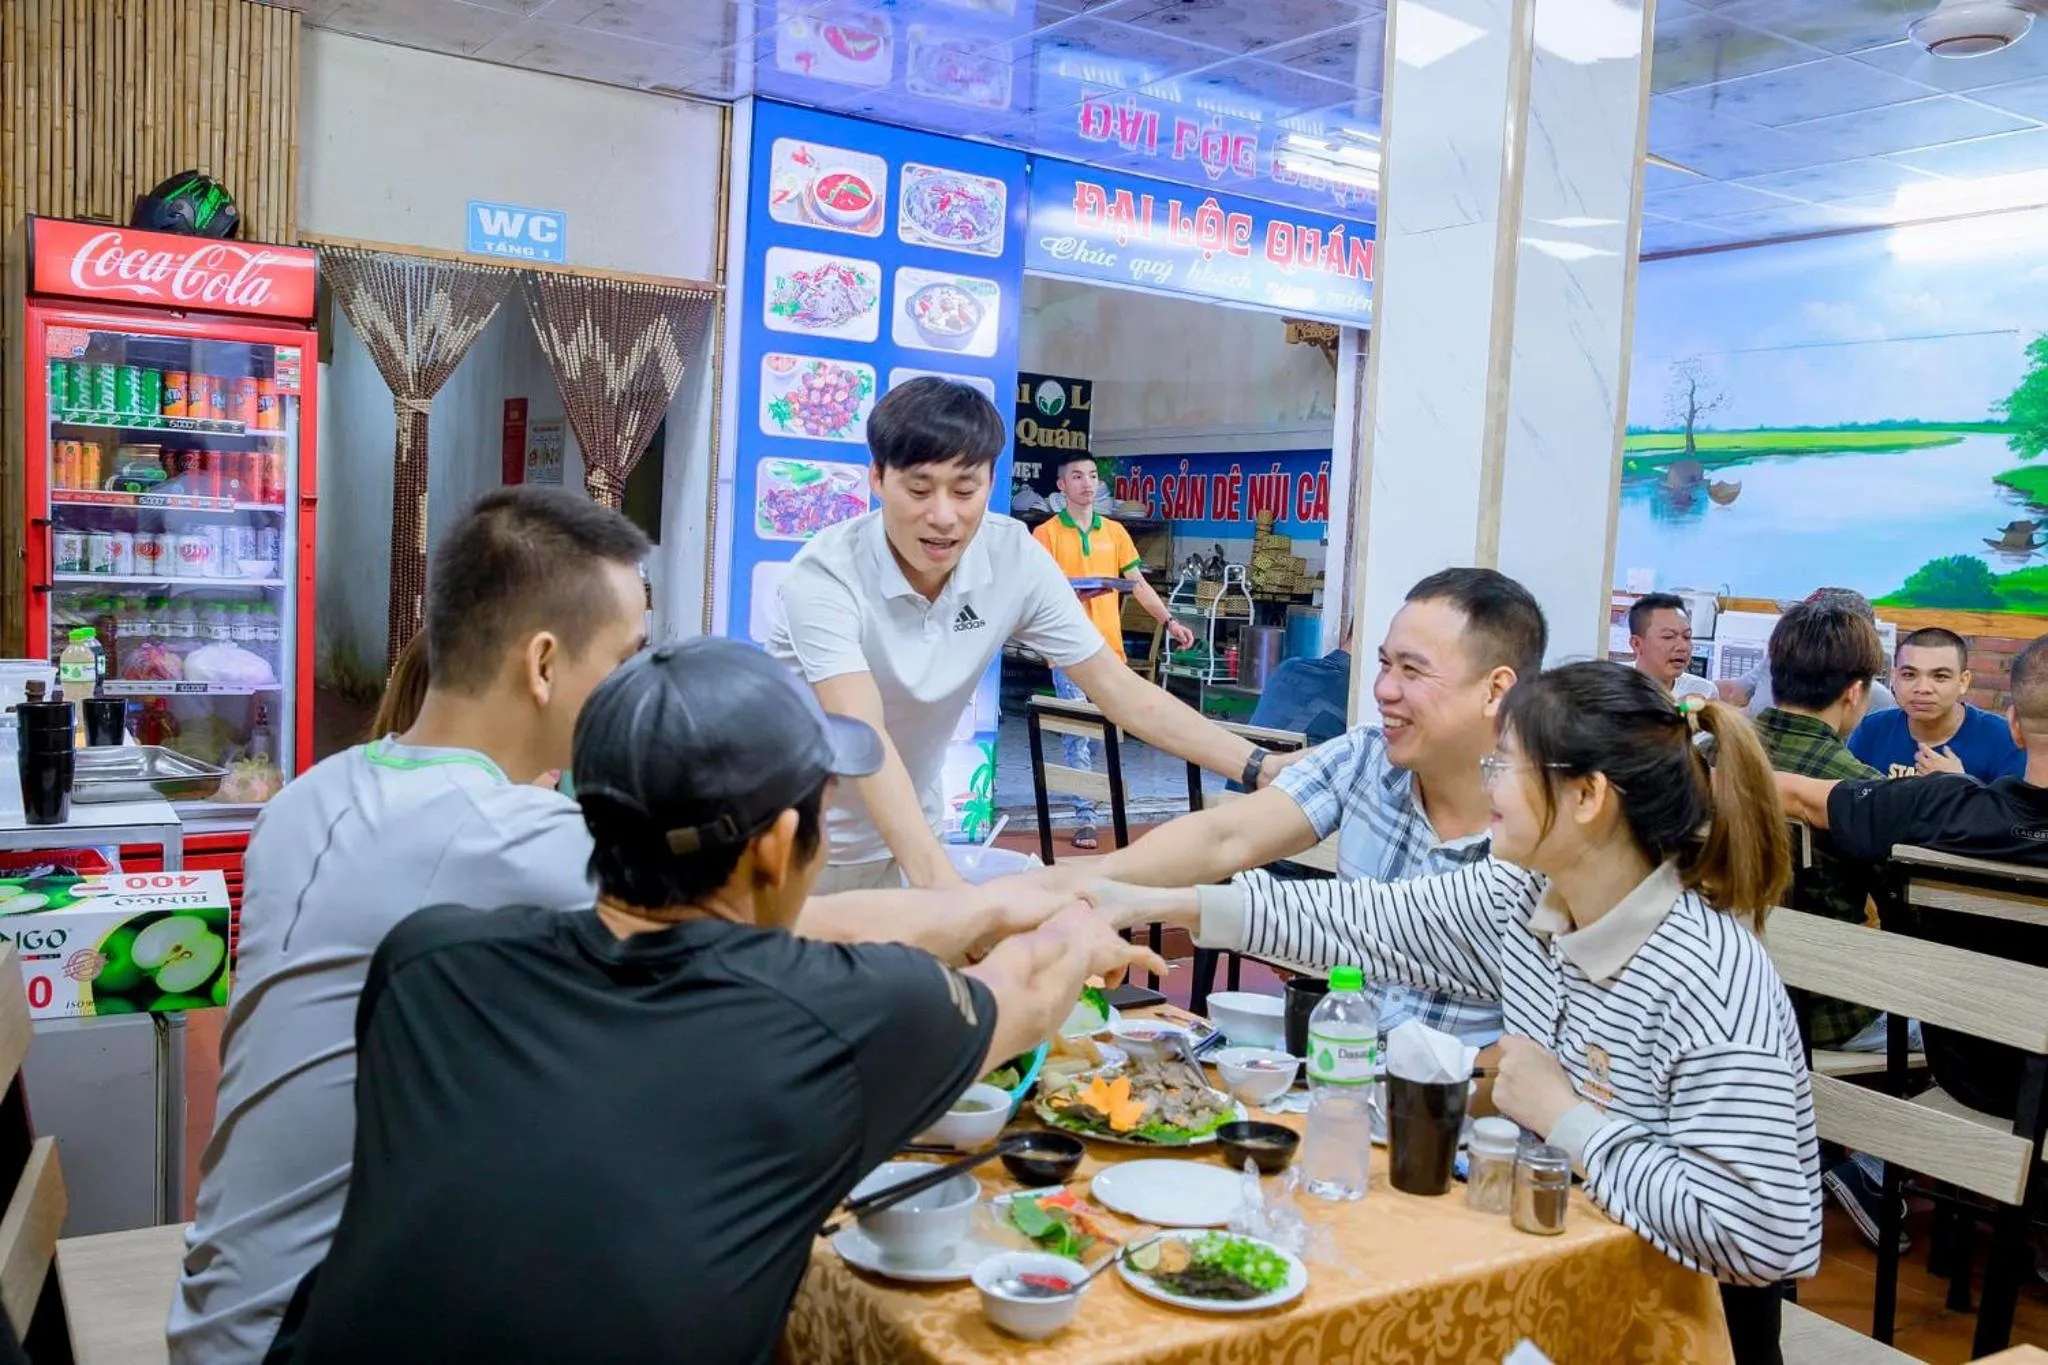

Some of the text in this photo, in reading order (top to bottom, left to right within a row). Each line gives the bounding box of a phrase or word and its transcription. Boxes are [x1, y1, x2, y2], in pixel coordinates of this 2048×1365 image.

[477, 208, 558, 242] WC
[1073, 181, 1376, 281] ĐẠI LỘC QUÁN
[69, 231, 275, 307] Coca-Cola
[543, 249, 550, 260] 1
[1040, 236, 1117, 267] Chúc
[1130, 256, 1174, 283] quý
[1015, 417, 1088, 450] Quán
[1161, 458, 1207, 521] SẢN
[1212, 463, 1242, 521] DÊ
[1247, 462, 1290, 522] NÚI
[1296, 460, 1330, 523] CÁ
[953, 619, 986, 632] adidas
[125, 875, 200, 890] 400
[114, 895, 208, 906] RINGO
